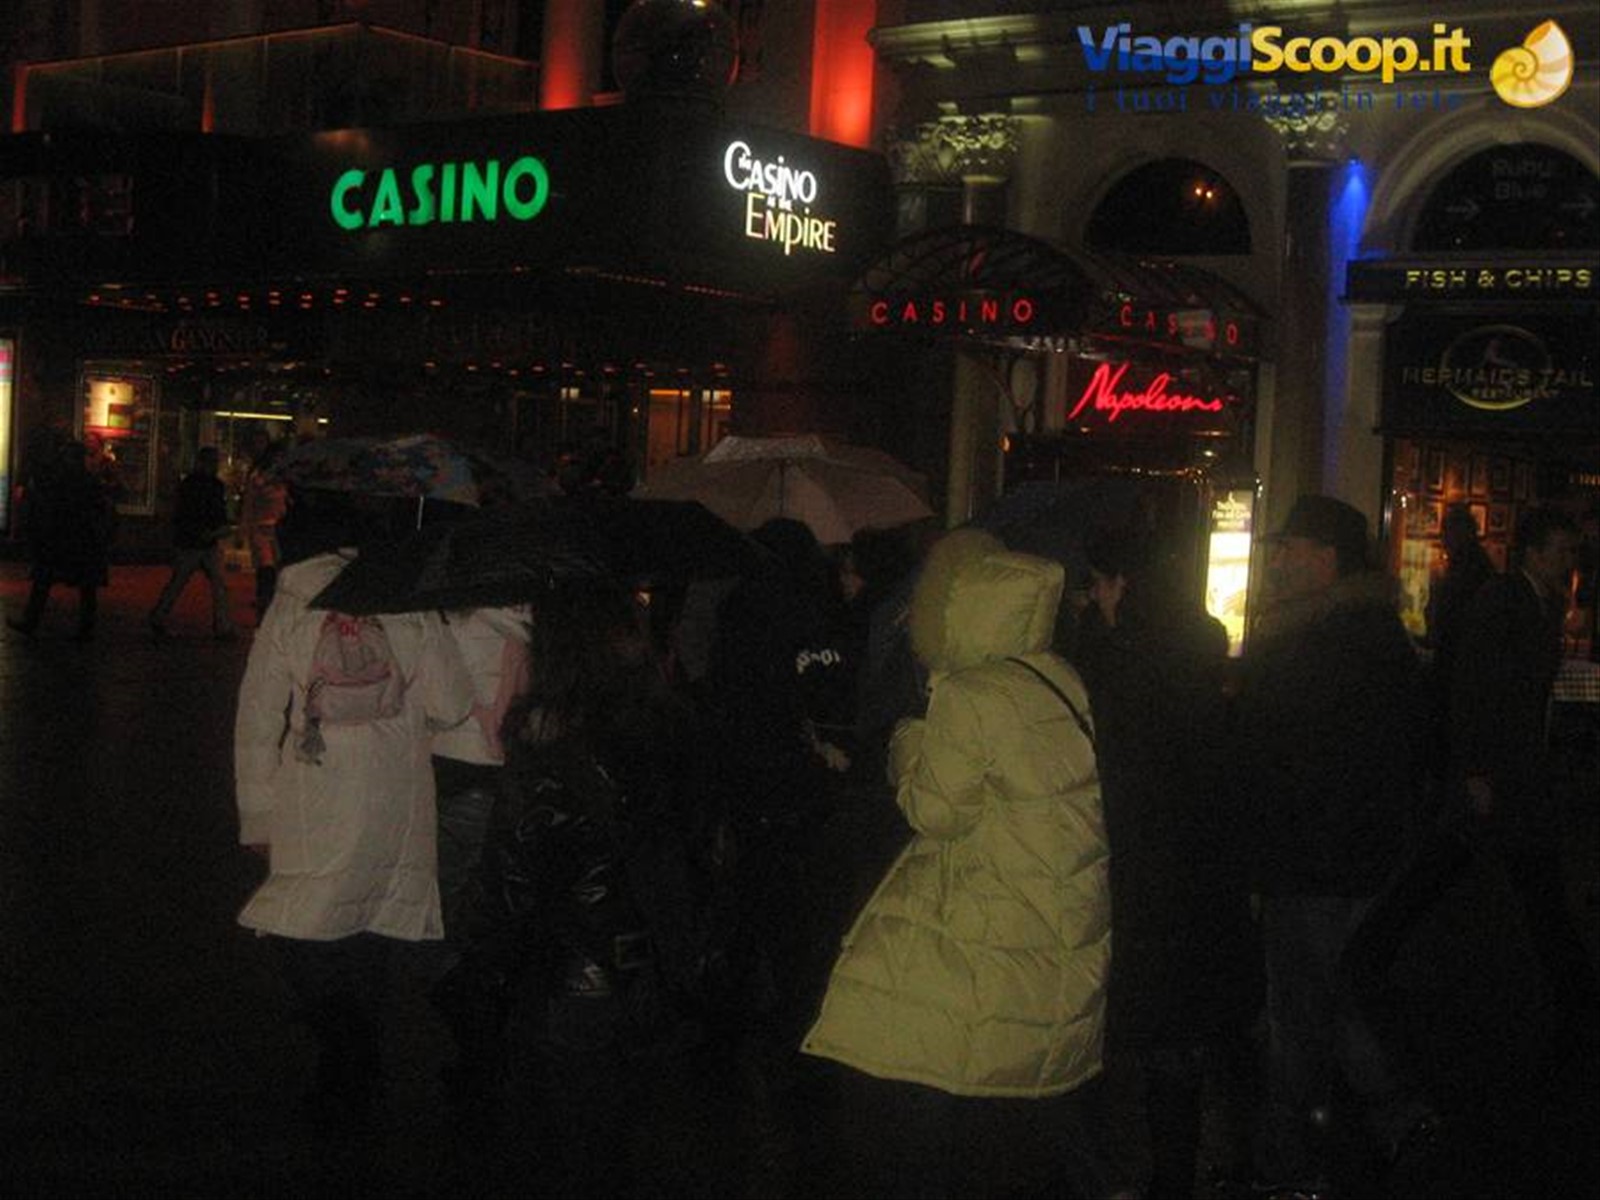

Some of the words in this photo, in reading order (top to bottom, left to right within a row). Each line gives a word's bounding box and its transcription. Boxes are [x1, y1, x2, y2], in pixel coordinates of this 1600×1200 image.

[330, 155, 550, 230] CASINO
[1405, 268, 1468, 290] FISH
[1504, 268, 1592, 290] CHIPS
[871, 298, 1034, 324] CASINO
[1120, 302, 1239, 345] CASINO
[1537, 368, 1594, 387] TAIL
